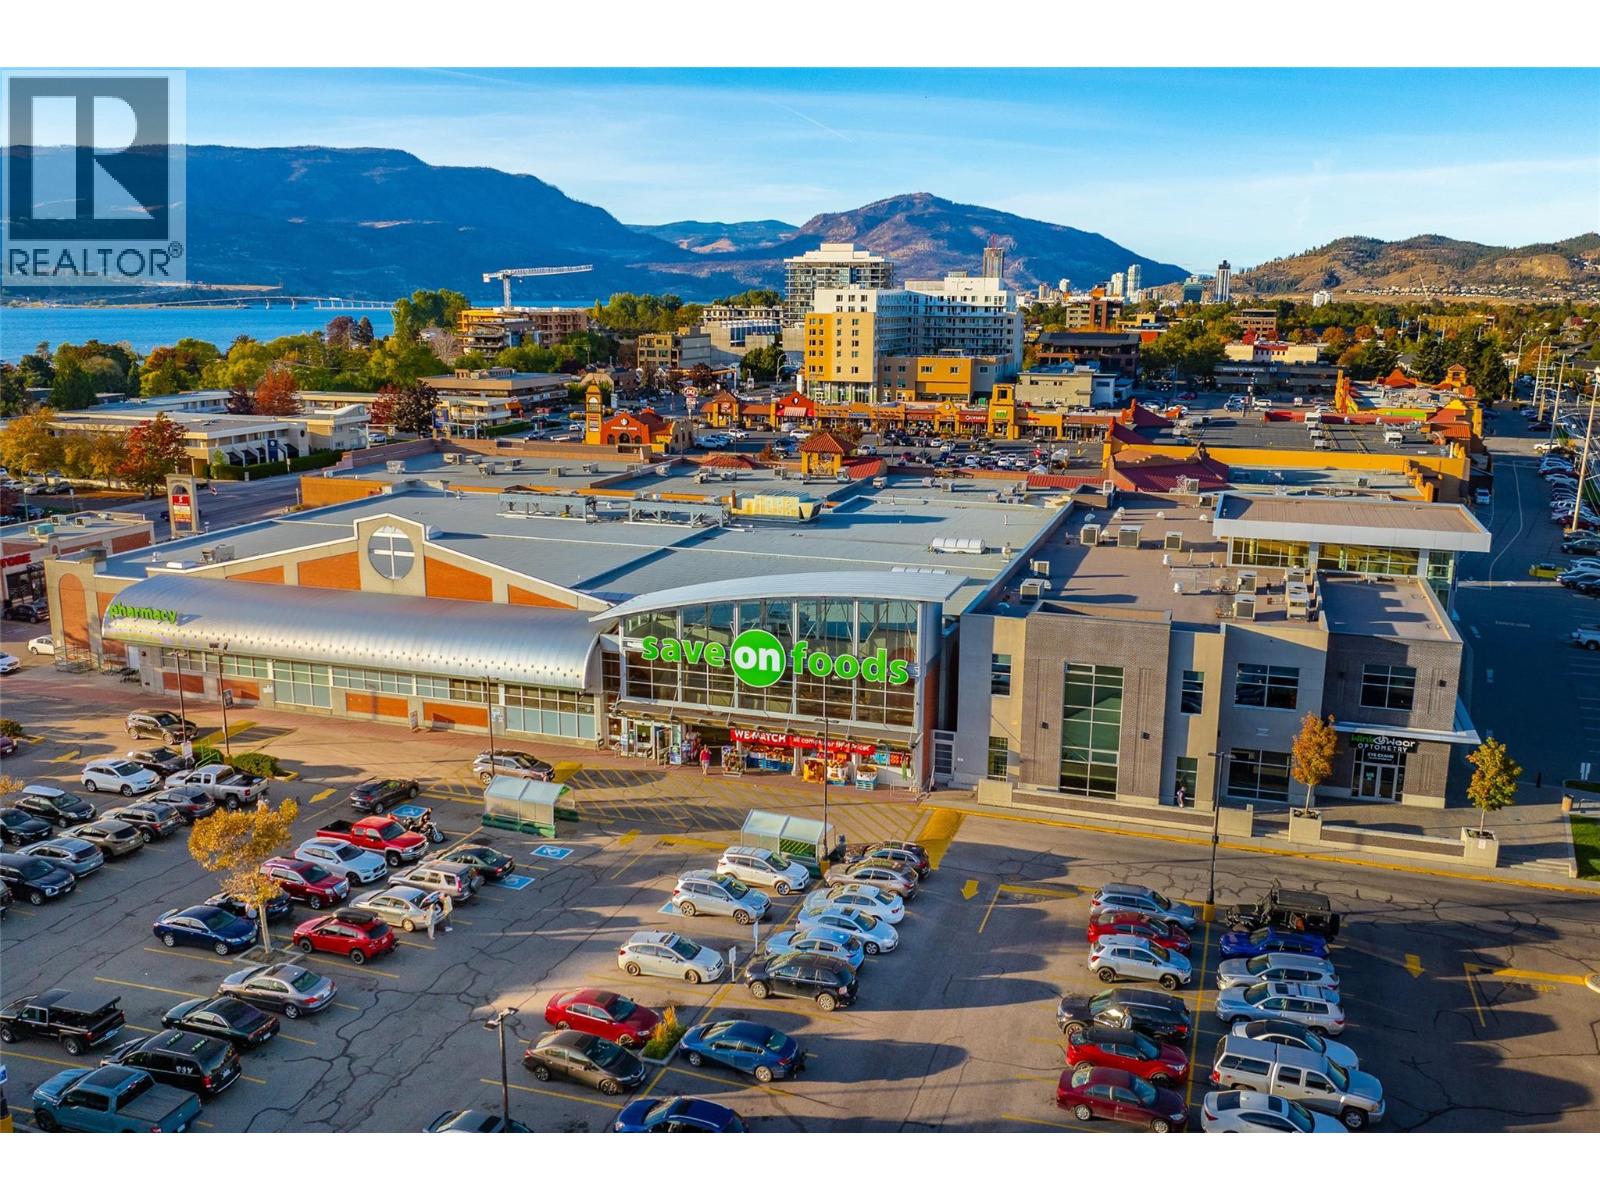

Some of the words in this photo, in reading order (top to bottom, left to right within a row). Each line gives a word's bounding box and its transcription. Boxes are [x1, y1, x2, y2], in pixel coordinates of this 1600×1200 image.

[110, 602, 177, 623] pharmacy
[641, 635, 726, 668] save
[735, 646, 780, 672] on
[791, 640, 909, 684] foods
[735, 729, 751, 740] WE
[751, 731, 786, 743] MATCH
[1357, 743, 1408, 753] OPTOMETRY
